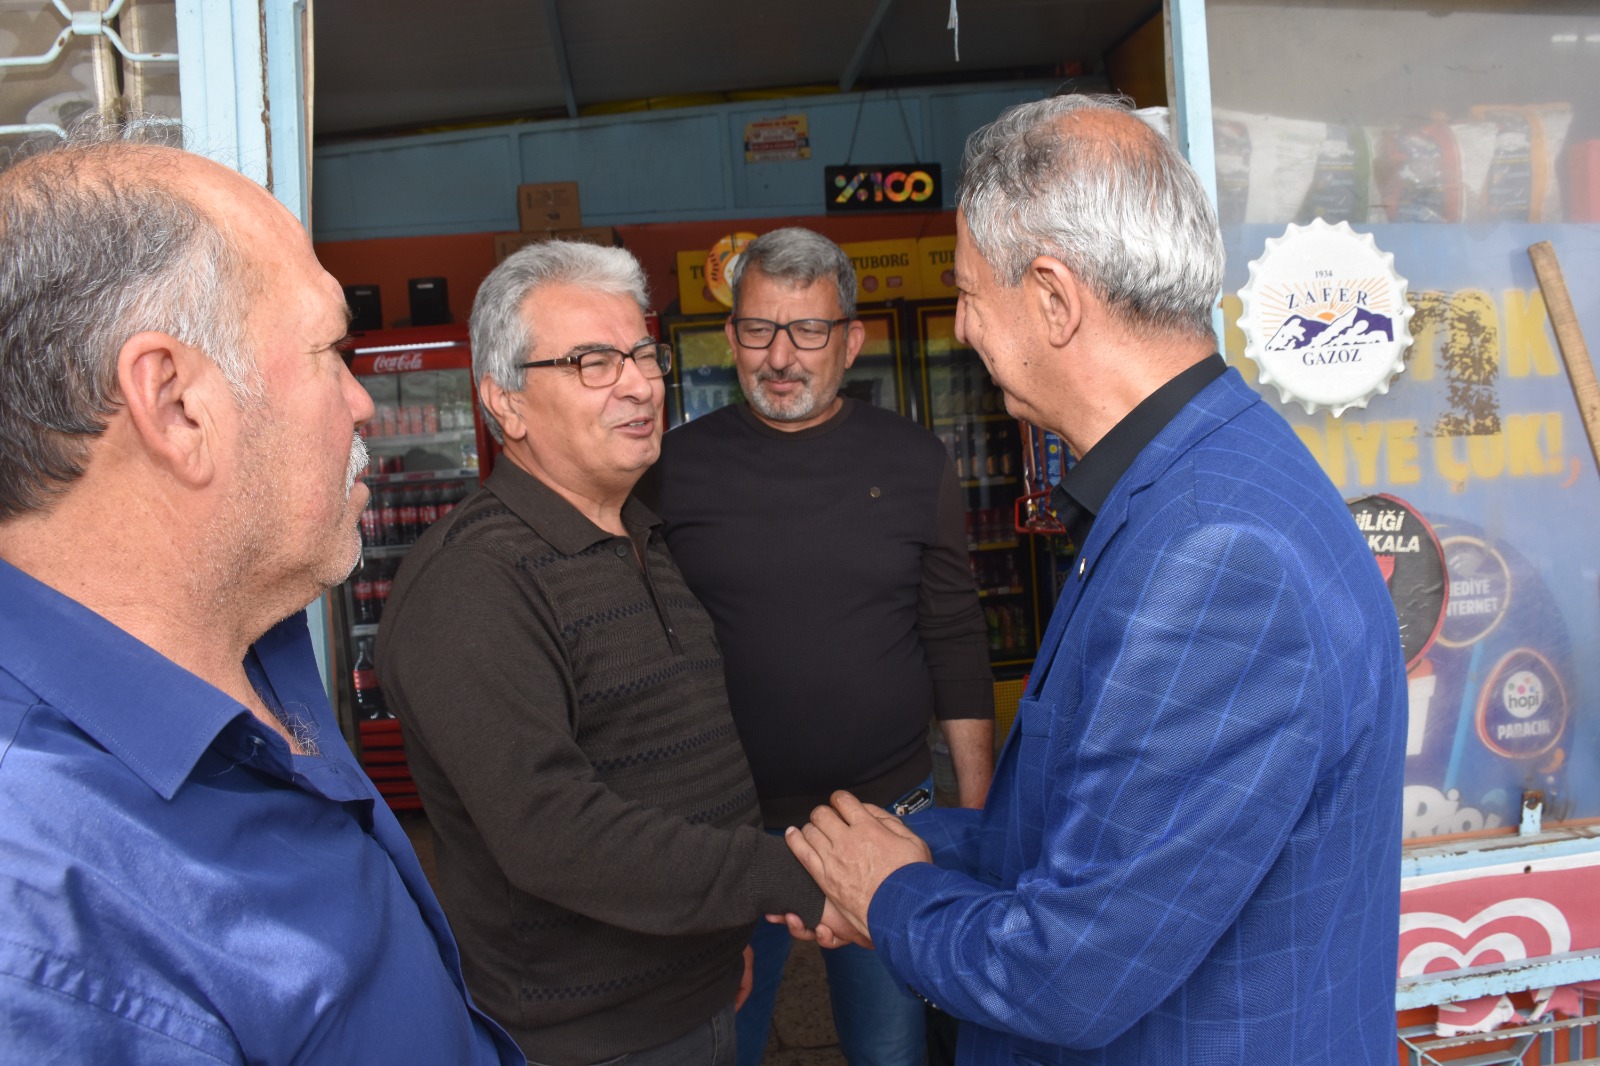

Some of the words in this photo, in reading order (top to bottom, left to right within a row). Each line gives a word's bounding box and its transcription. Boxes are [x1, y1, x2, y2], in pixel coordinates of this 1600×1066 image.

[835, 170, 934, 203] %100
[850, 252, 909, 271] TUBORG
[1315, 269, 1333, 279] 1934
[1285, 287, 1368, 310] ZAFER
[1302, 348, 1362, 367] GAZOZ
[1363, 534, 1421, 553] KALA
[1508, 690, 1540, 710] hopi
